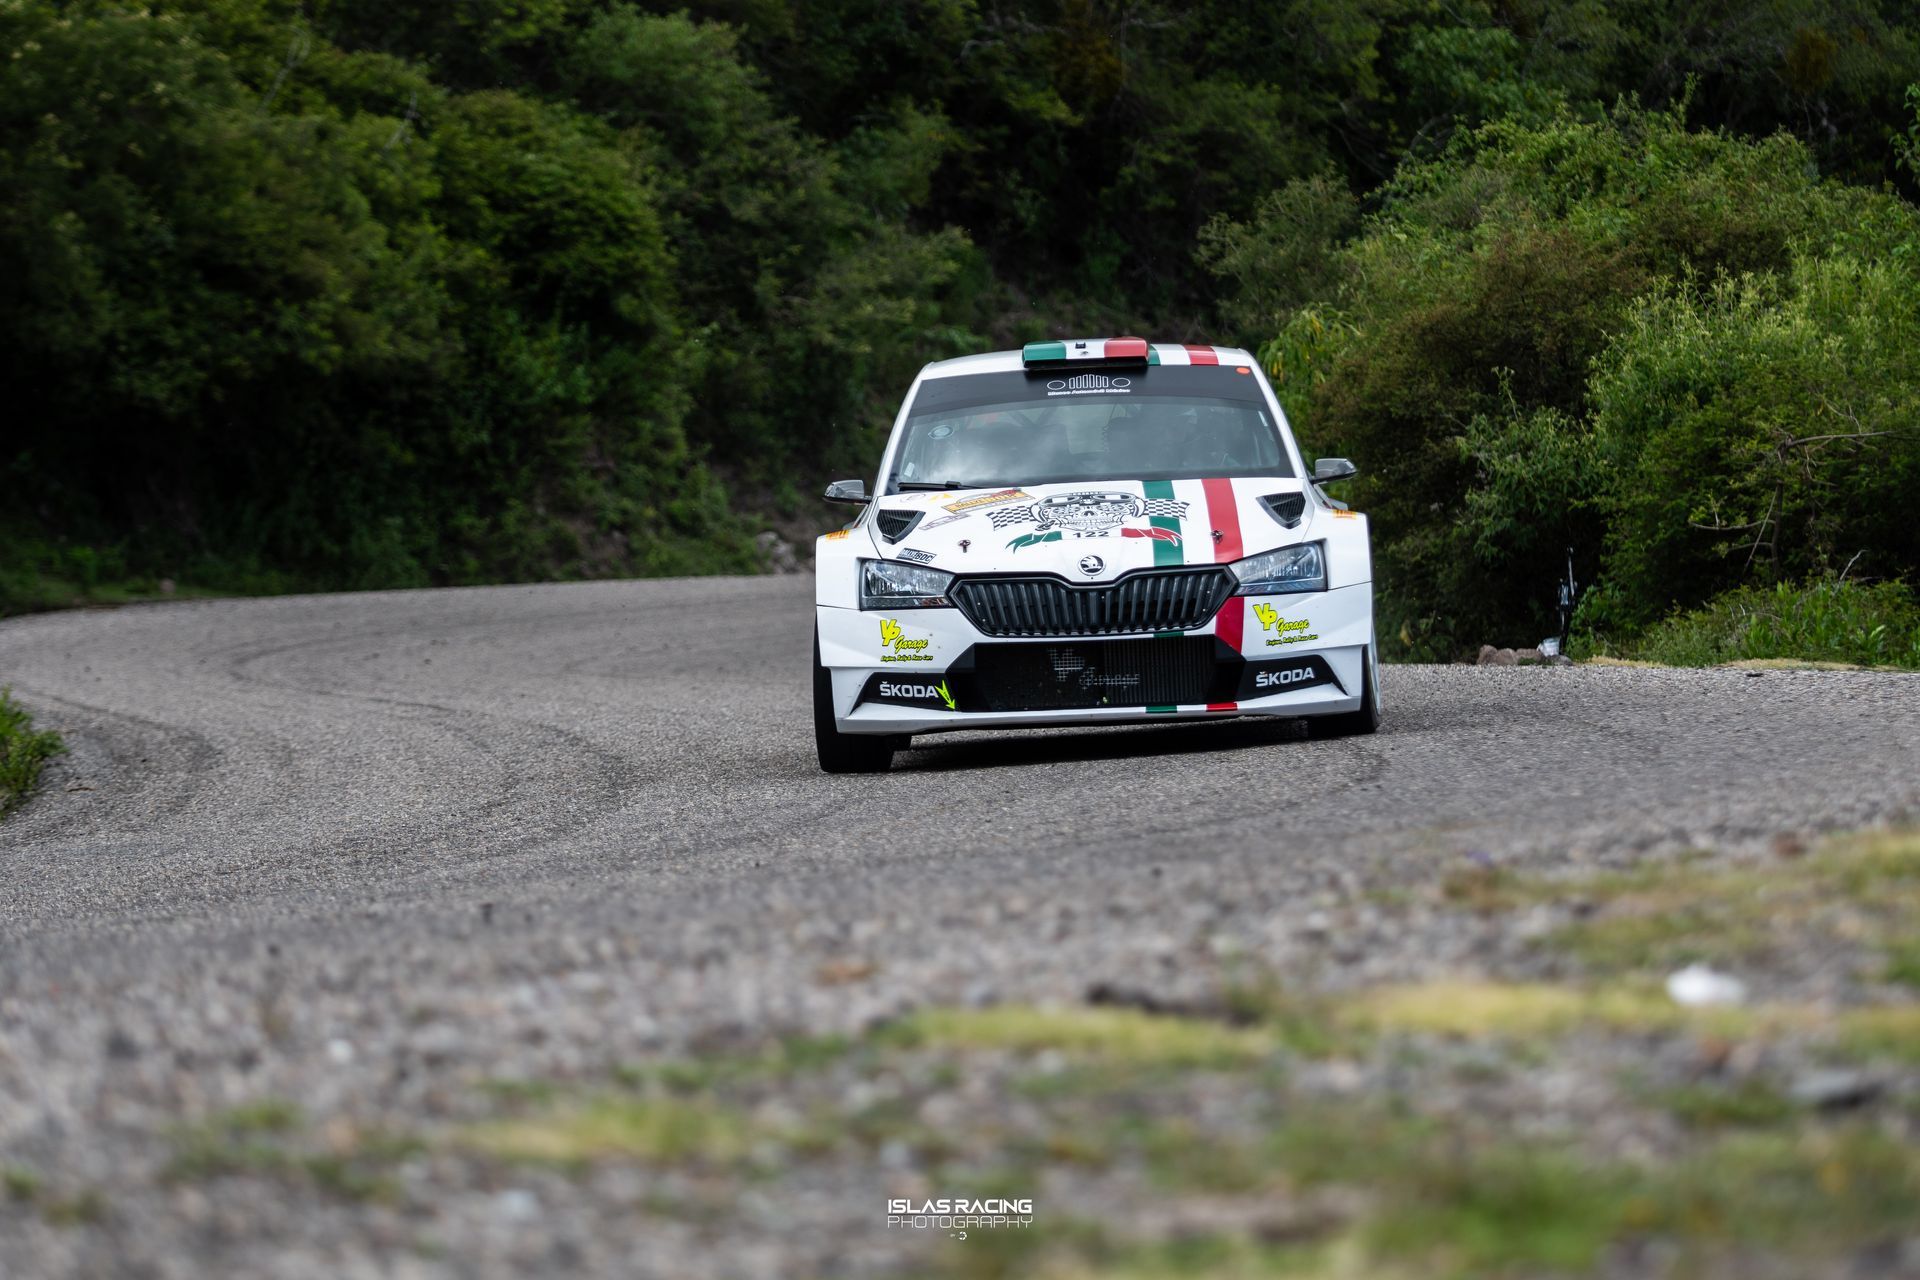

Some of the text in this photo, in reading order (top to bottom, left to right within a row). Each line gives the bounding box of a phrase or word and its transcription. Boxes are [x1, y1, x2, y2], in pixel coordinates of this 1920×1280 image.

[1276, 618, 1309, 637] Garage
[894, 635, 928, 654] Garage
[1256, 667, 1315, 687] ŠKODA
[880, 681, 939, 698] ŠKODA
